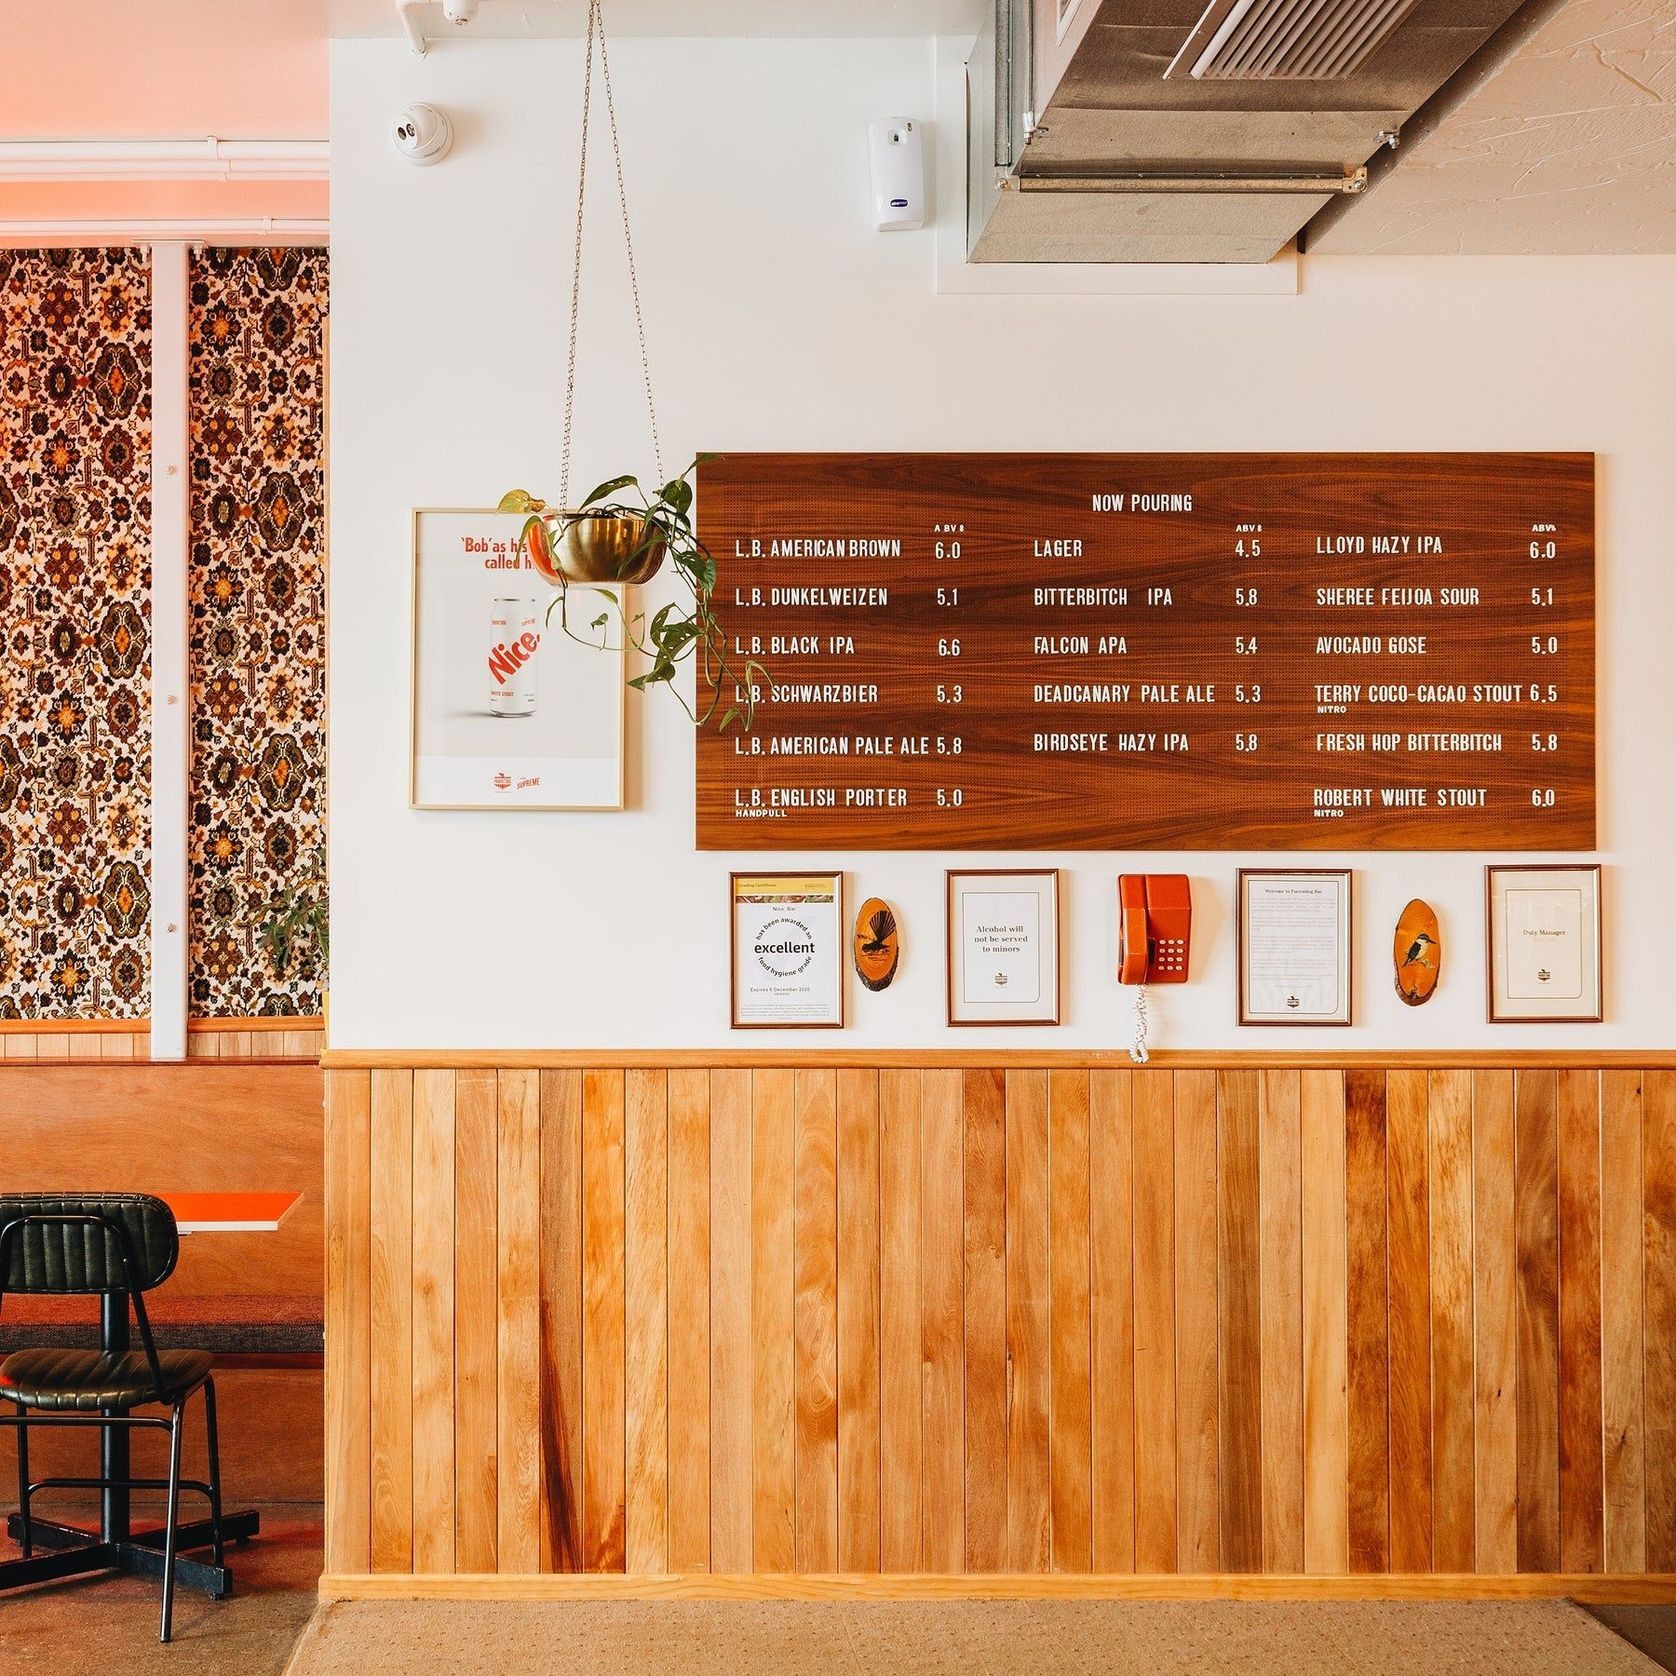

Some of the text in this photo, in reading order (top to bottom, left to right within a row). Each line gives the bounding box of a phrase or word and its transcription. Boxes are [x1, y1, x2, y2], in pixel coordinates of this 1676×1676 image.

[1092, 494, 1192, 512] NOW POURING
[492, 542, 506, 552] as
[510, 537, 528, 552] hs
[735, 539, 961, 560] L.B. AMERICAN BROWN 6.0
[1034, 539, 1261, 558] LAGER 4.5
[1316, 536, 1556, 559] LLOYD HAZY IPA 6.0
[735, 587, 958, 607] L.B. DUNKELWEIZEN 5.1
[1034, 587, 1258, 607] BITTERBITCH IPA 5.8
[1316, 587, 1553, 607] SHEREE FEIJOA SOUR 5.1
[735, 636, 960, 657] L.B. BLACK IPA 6.6
[1034, 636, 1258, 655] FALCON APA 5.4
[1316, 636, 1558, 655] AVOCADO GOSE 5.0
[771, 684, 878, 703] SCHWARZBIER
[937, 684, 962, 704] 5.3
[1034, 684, 1261, 704] DEADCANARY PALE ALE 5.3
[1314, 683, 1558, 703] TERRY COCO-CACAO STOUT 6.5
[1317, 705, 1347, 714] NITRO
[735, 736, 962, 756] L.B. AMERICAN PALE ALE 5.8
[1033, 733, 1258, 752] BIRDSEYE HAZY IPA 5.8
[1316, 733, 1558, 752] FRESH HOP BITTERBITCH 5.8
[735, 788, 962, 808] L.B. ENGLISH PORTER 5.0
[1313, 788, 1555, 807] ROBERT WHITE STOUT 6.0
[735, 808, 788, 818] HANDPULL
[1313, 809, 1344, 818] NITRO
[755, 917, 813, 941] has been awarded an
[976, 925, 1024, 933] Alcohol will
[754, 941, 815, 954] excellent
[989, 935, 1000, 943] be
[1001, 935, 1028, 943] served
[758, 955, 812, 978] food hygiene grade
